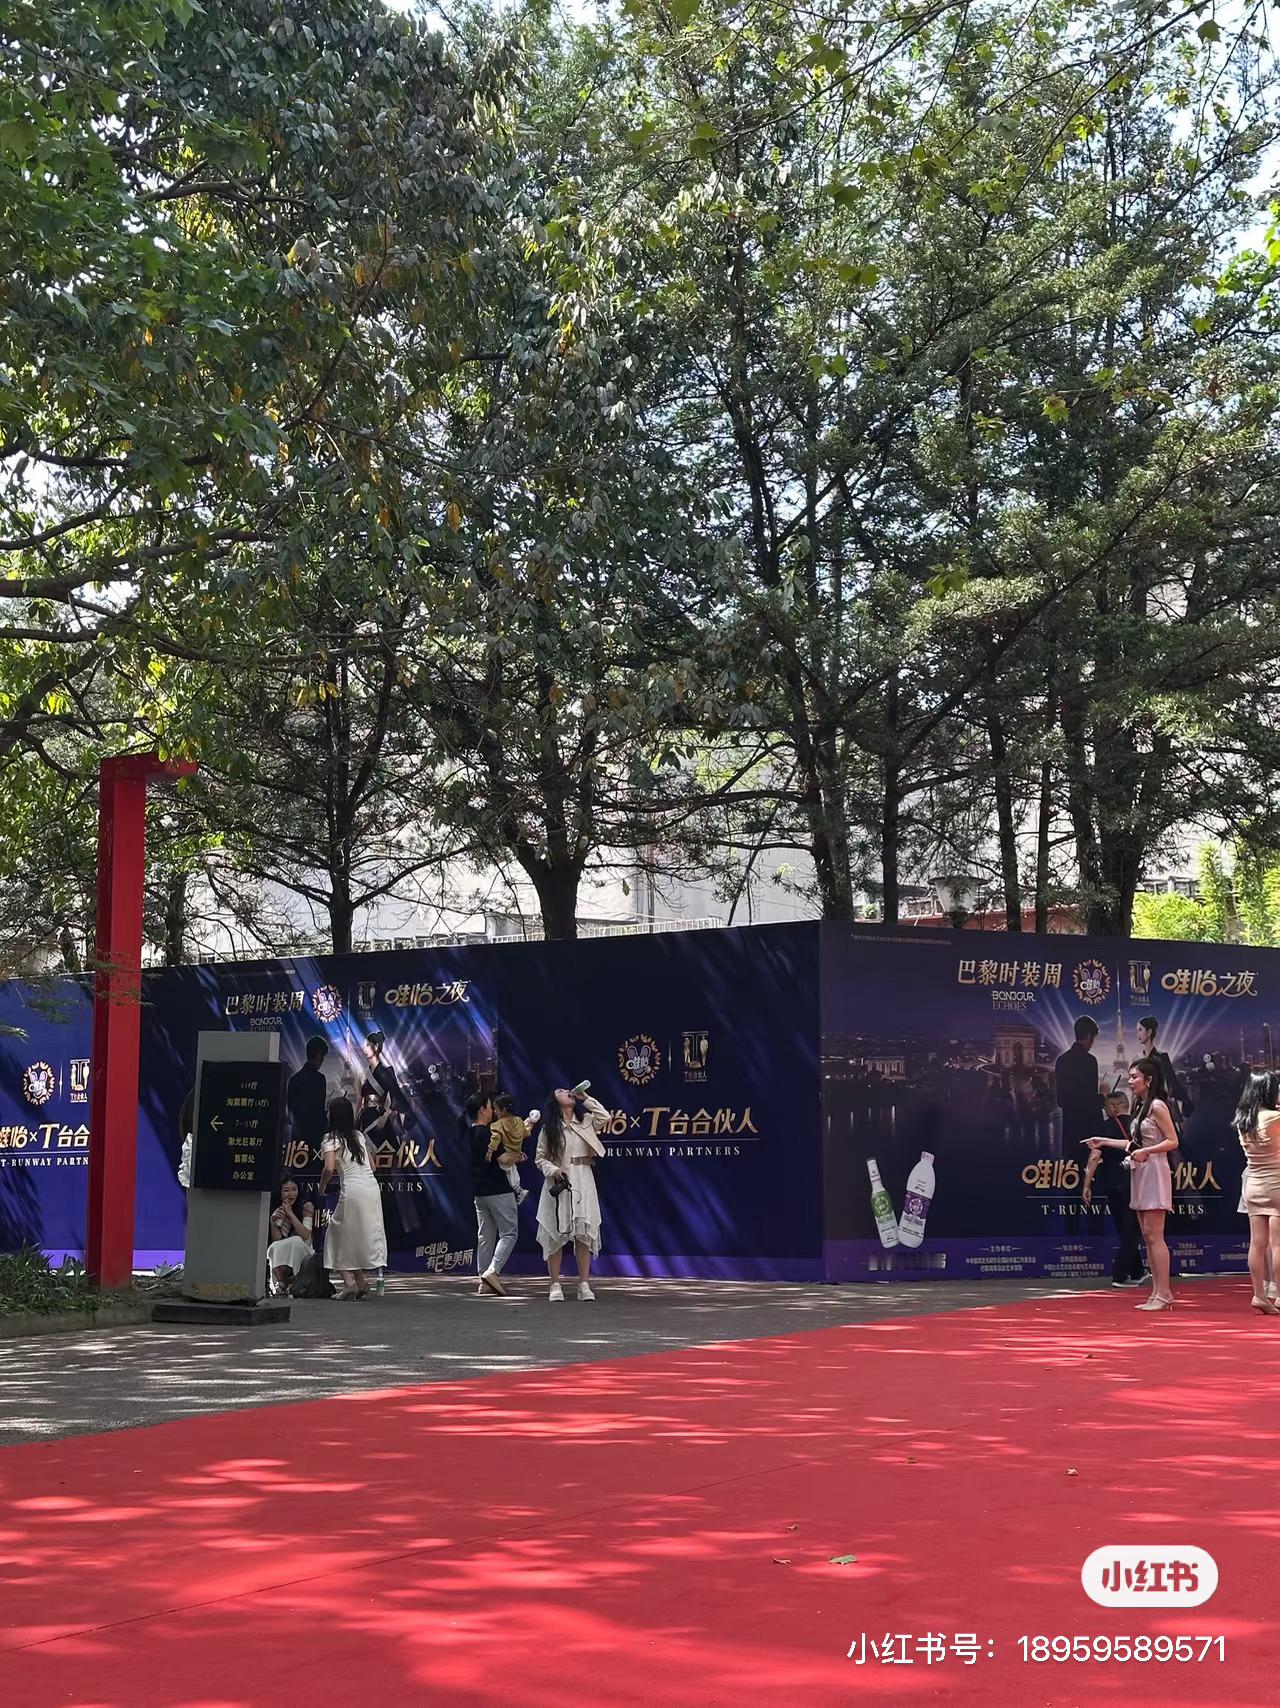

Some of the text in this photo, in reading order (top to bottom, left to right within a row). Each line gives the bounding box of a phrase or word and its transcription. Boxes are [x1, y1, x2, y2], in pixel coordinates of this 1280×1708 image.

[957, 959, 1062, 988] 巴黎时装周
[1161, 968, 1258, 998] 唯怡之夜
[225, 990, 304, 1015] 巴黎时装周
[384, 979, 470, 1007] 唯怡之夜
[992, 1001, 1027, 1011] ECHOES
[669, 1146, 741, 1157] PARTNERS
[232, 1171, 255, 1181] 办公室
